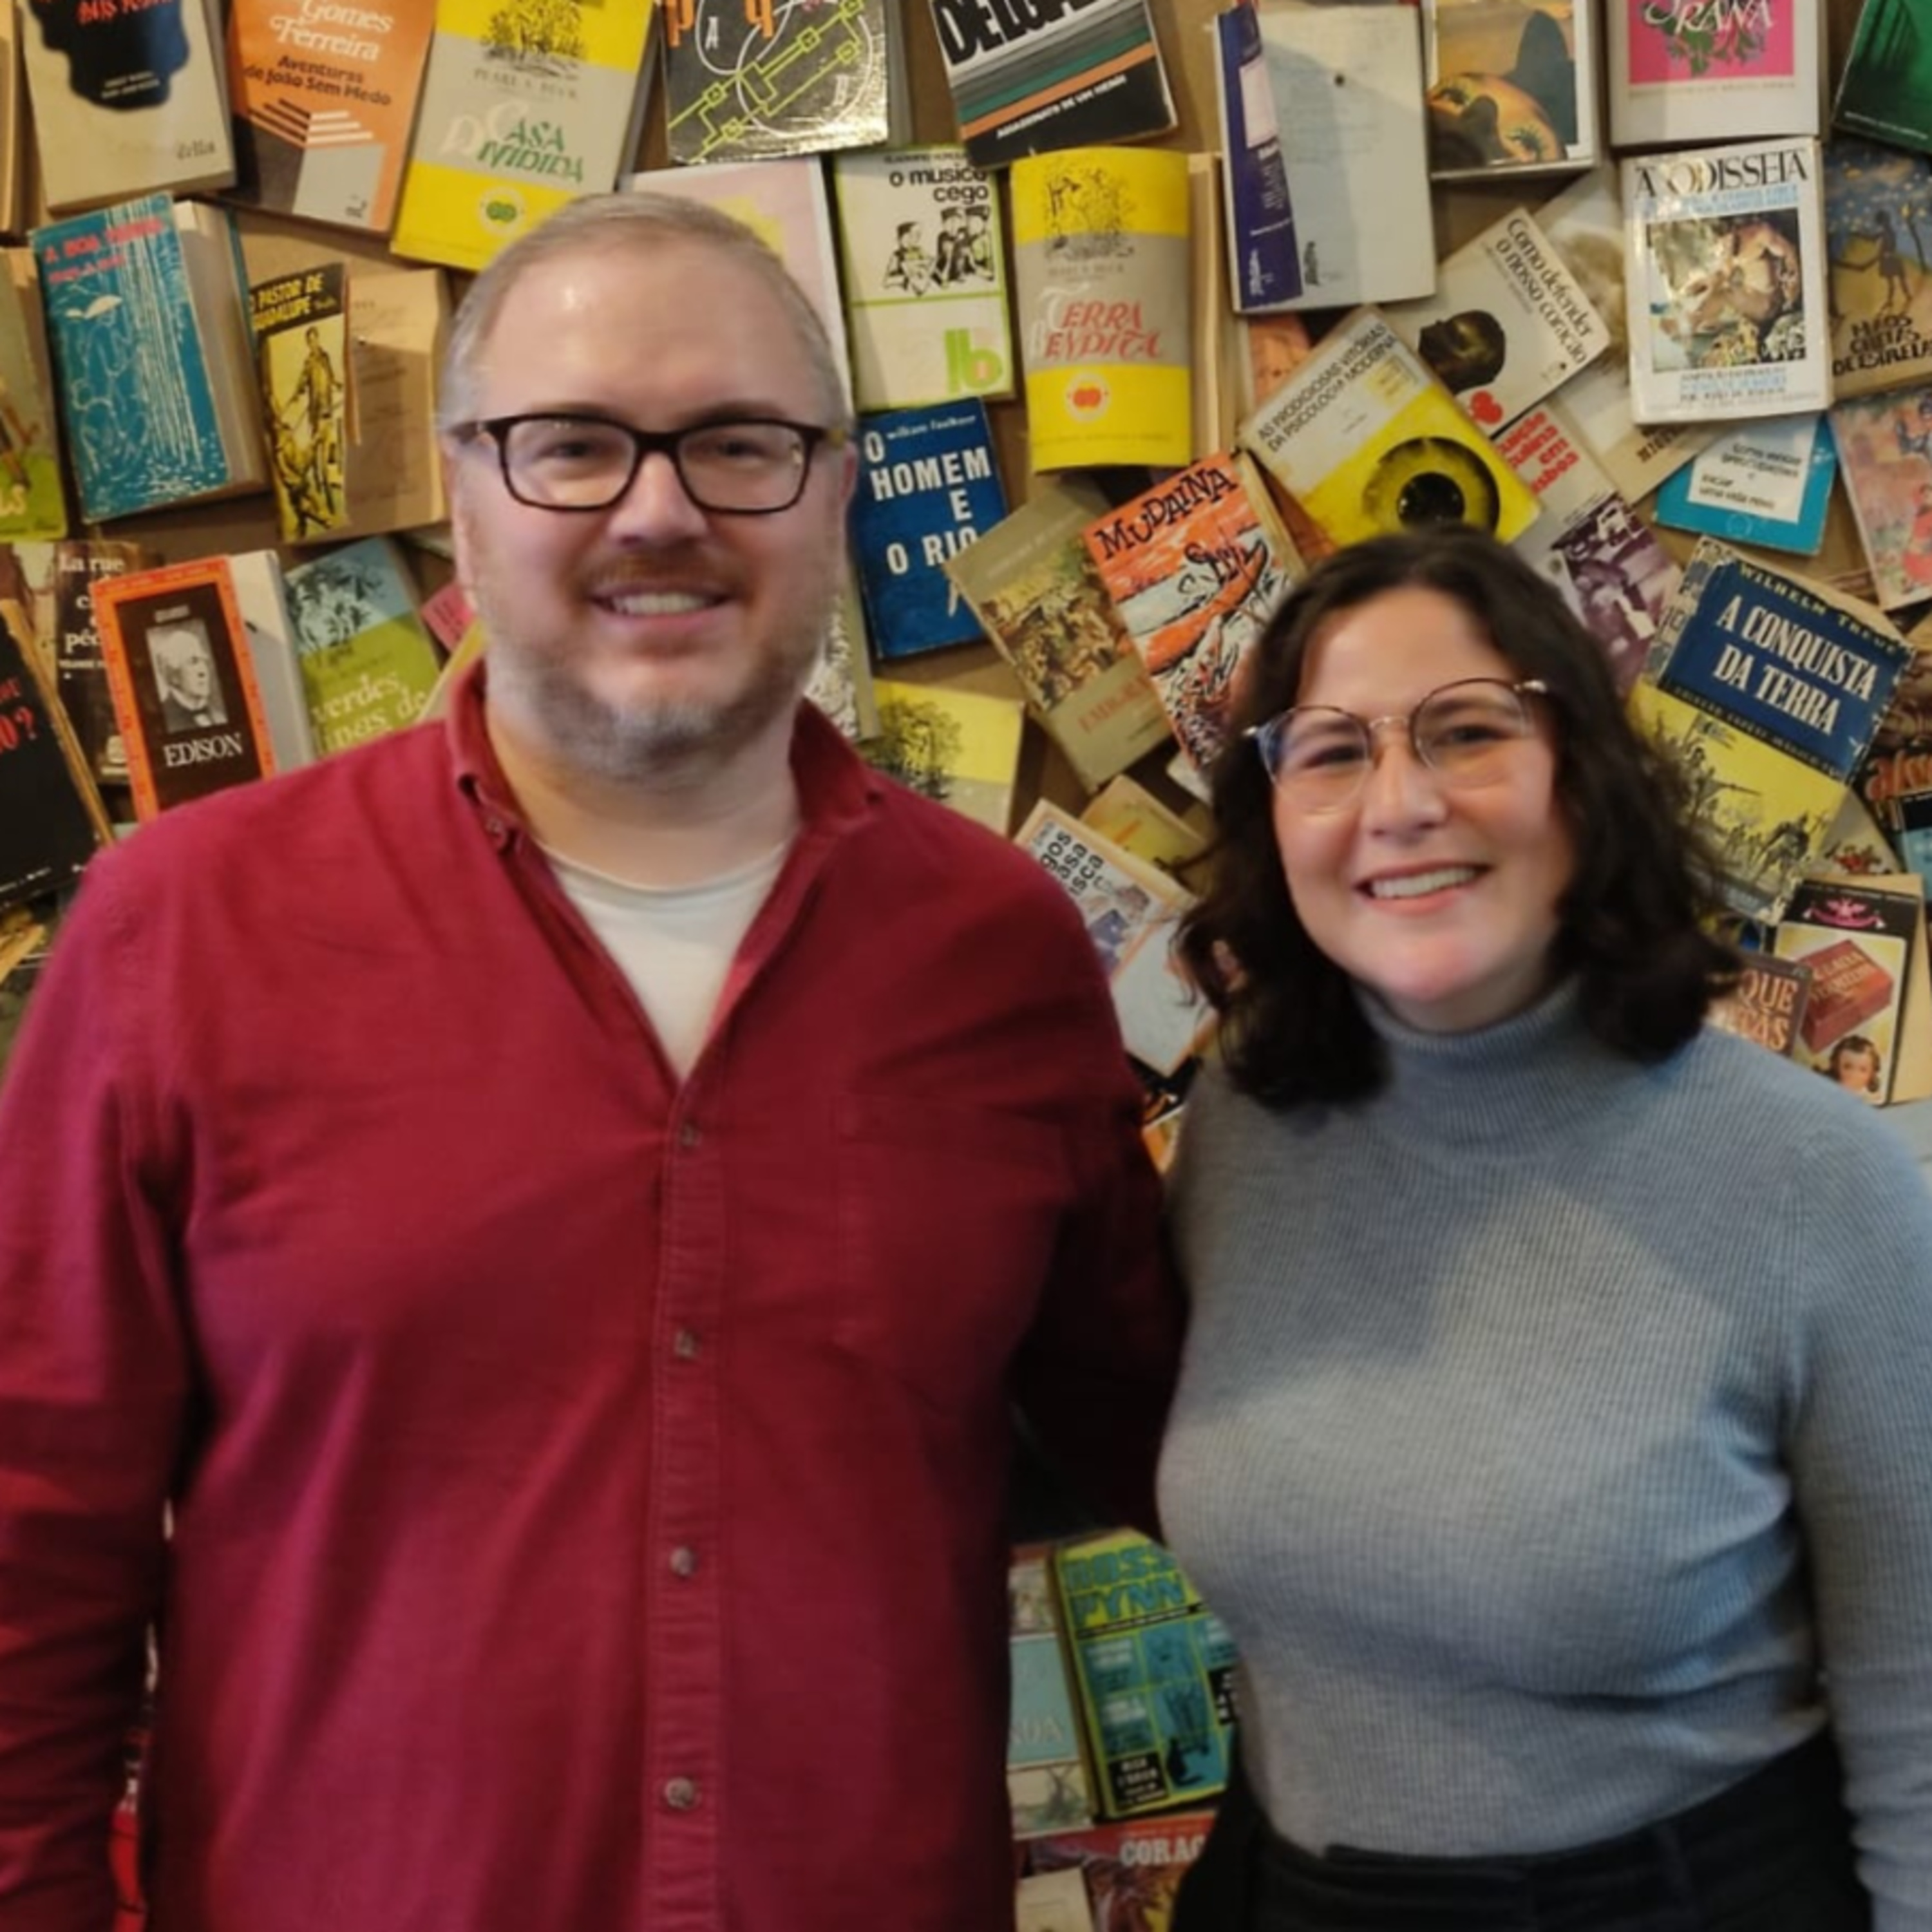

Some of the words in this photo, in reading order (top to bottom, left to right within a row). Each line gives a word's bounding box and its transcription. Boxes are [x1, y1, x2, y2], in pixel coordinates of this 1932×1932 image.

[303, 0, 393, 32] Gomes
[270, 14, 379, 61] Ferreira
[243, 65, 262, 79] de
[265, 68, 303, 86] João
[307, 77, 341, 95] Sem
[345, 85, 390, 105] Medo
[278, 55, 364, 83] Aventuras
[889, 173, 903, 187] o
[1634, 166, 1656, 198] A
[1667, 148, 1808, 194] ODISSEIA
[933, 185, 989, 205] cego
[1495, 238, 1512, 254] o
[1504, 253, 1545, 301] nosso
[1508, 219, 1547, 270] Como
[1540, 267, 1593, 336] defender
[864, 431, 885, 463] O
[870, 446, 991, 502] HOMEM
[949, 489, 972, 521] E
[59, 555, 86, 573] La
[90, 556, 124, 573] rue
[886, 543, 909, 574] O
[1739, 562, 1826, 616] WILHELM
[1716, 594, 1743, 632] A
[1742, 607, 1879, 701] CONQUISTA
[312, 672, 400, 723] verdes
[1714, 645, 1755, 692] DA
[1756, 665, 1841, 735] TERRA
[164, 733, 244, 768] EDISON
